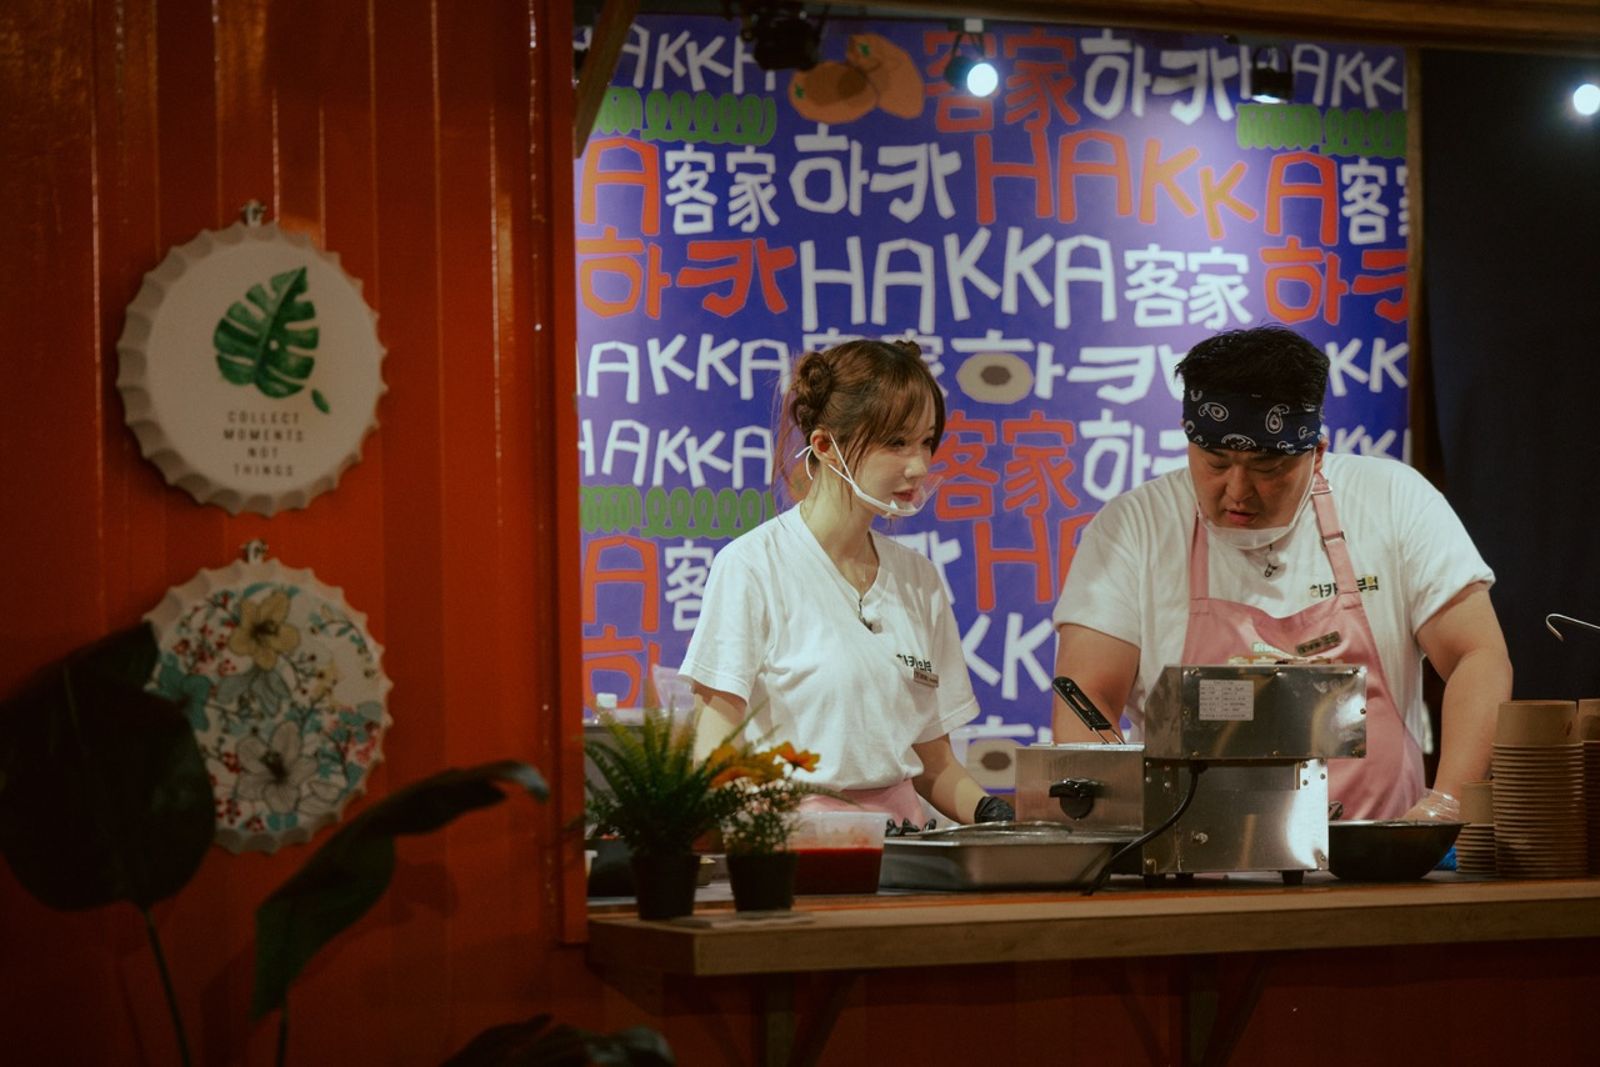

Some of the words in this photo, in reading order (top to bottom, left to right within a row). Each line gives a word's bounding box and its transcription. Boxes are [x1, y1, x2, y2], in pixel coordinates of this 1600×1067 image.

[1081, 28, 1236, 125] 하카
[1240, 44, 1408, 110] HAKK
[665, 144, 781, 235] 客家
[789, 123, 962, 223] 하카
[1341, 158, 1408, 245] 客
[576, 227, 797, 321] 하카
[803, 227, 1117, 335] HAKKA
[1124, 243, 1254, 329] 客家
[576, 333, 791, 404] AKKA
[223, 429, 305, 443] MOMENTS
[227, 410, 300, 424] COLLECT
[247, 447, 278, 459] NOT
[233, 463, 294, 477] THINGS
